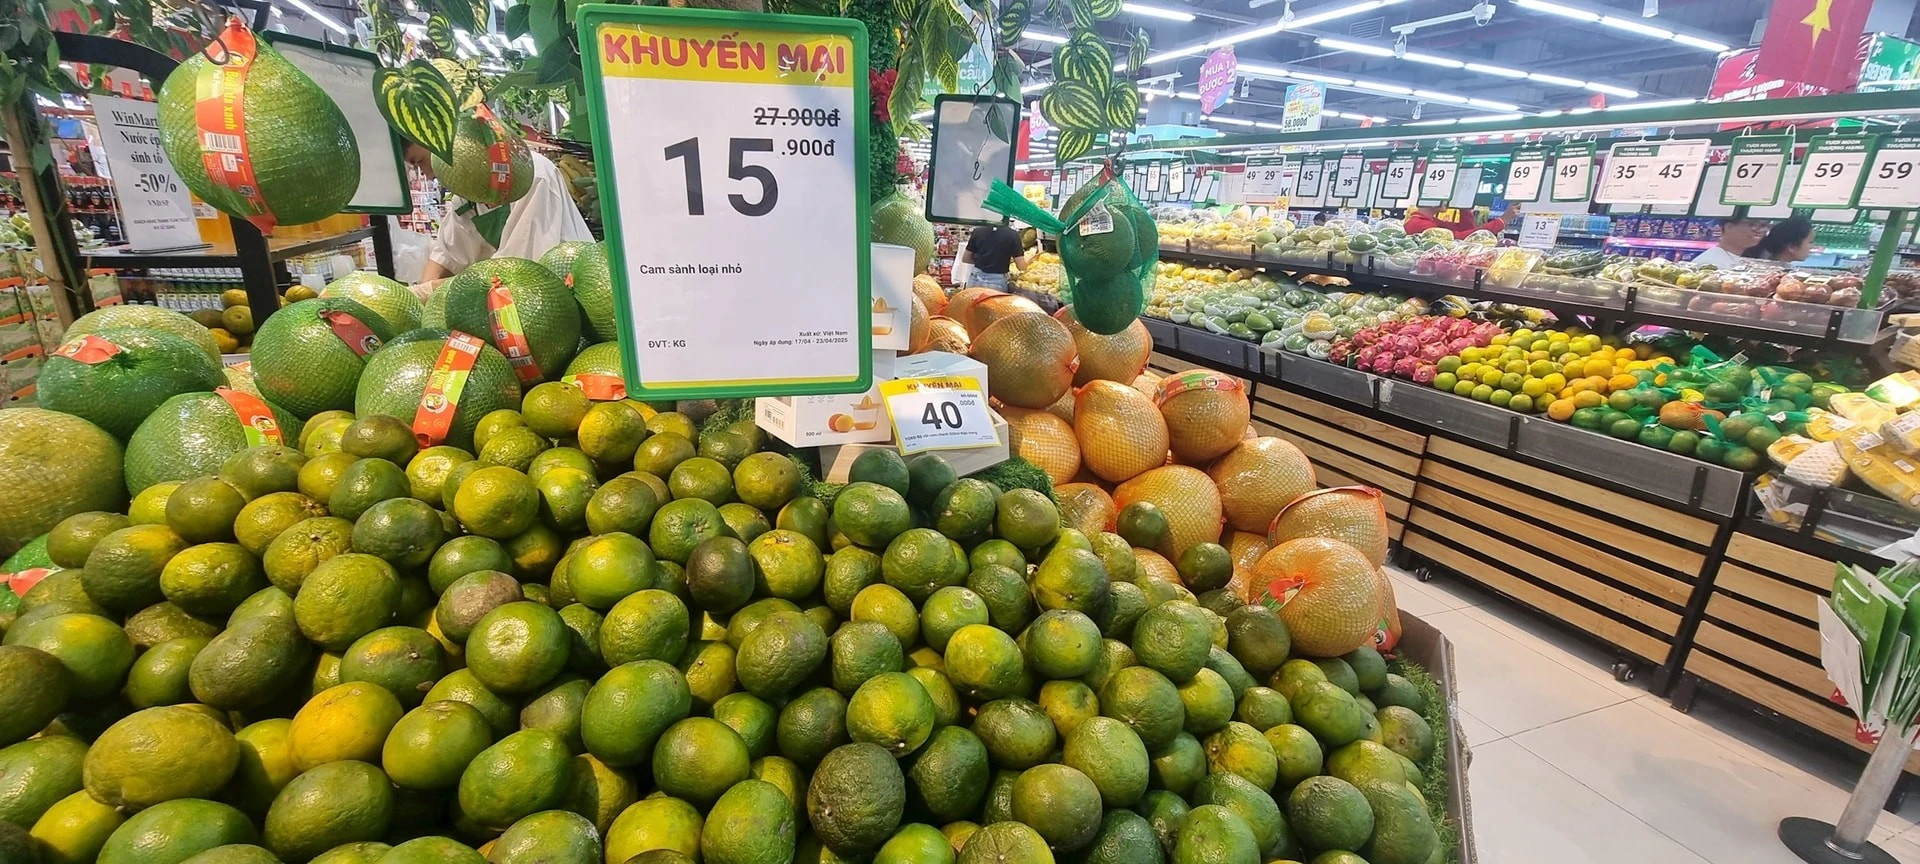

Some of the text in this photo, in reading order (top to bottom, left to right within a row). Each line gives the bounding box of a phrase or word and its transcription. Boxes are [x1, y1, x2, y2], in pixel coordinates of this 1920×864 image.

[603, 31, 845, 81] KHUYẾN MẠI
[1205, 62, 1224, 78] MUA
[1226, 67, 1236, 84] 2
[112, 110, 159, 128] WinMart
[224, 106, 237, 131] xanh
[754, 107, 840, 127] 27.900đ
[120, 130, 161, 149] Nước ép
[131, 151, 151, 164] sinh
[664, 136, 836, 217] 15 .900đ
[1246, 171, 1257, 180] 49
[1264, 170, 1276, 181] 29
[1303, 170, 1314, 181] 45
[1390, 167, 1404, 179] 45
[1429, 169, 1446, 181] 49
[1513, 166, 1531, 179] 69
[1560, 164, 1578, 178] 49
[1614, 164, 1637, 179] 35
[1658, 163, 1685, 179] 45
[1736, 163, 1765, 179] 67
[1814, 162, 1844, 178] 59
[1878, 162, 1914, 179] 59
[134, 173, 177, 194] -50%
[1342, 179, 1353, 187] 39
[1535, 221, 1547, 230] 13
[640, 262, 743, 276] Cam sành loại nhỏ
[648, 340, 687, 349] ĐVT: KG
[921, 401, 963, 430] 40
